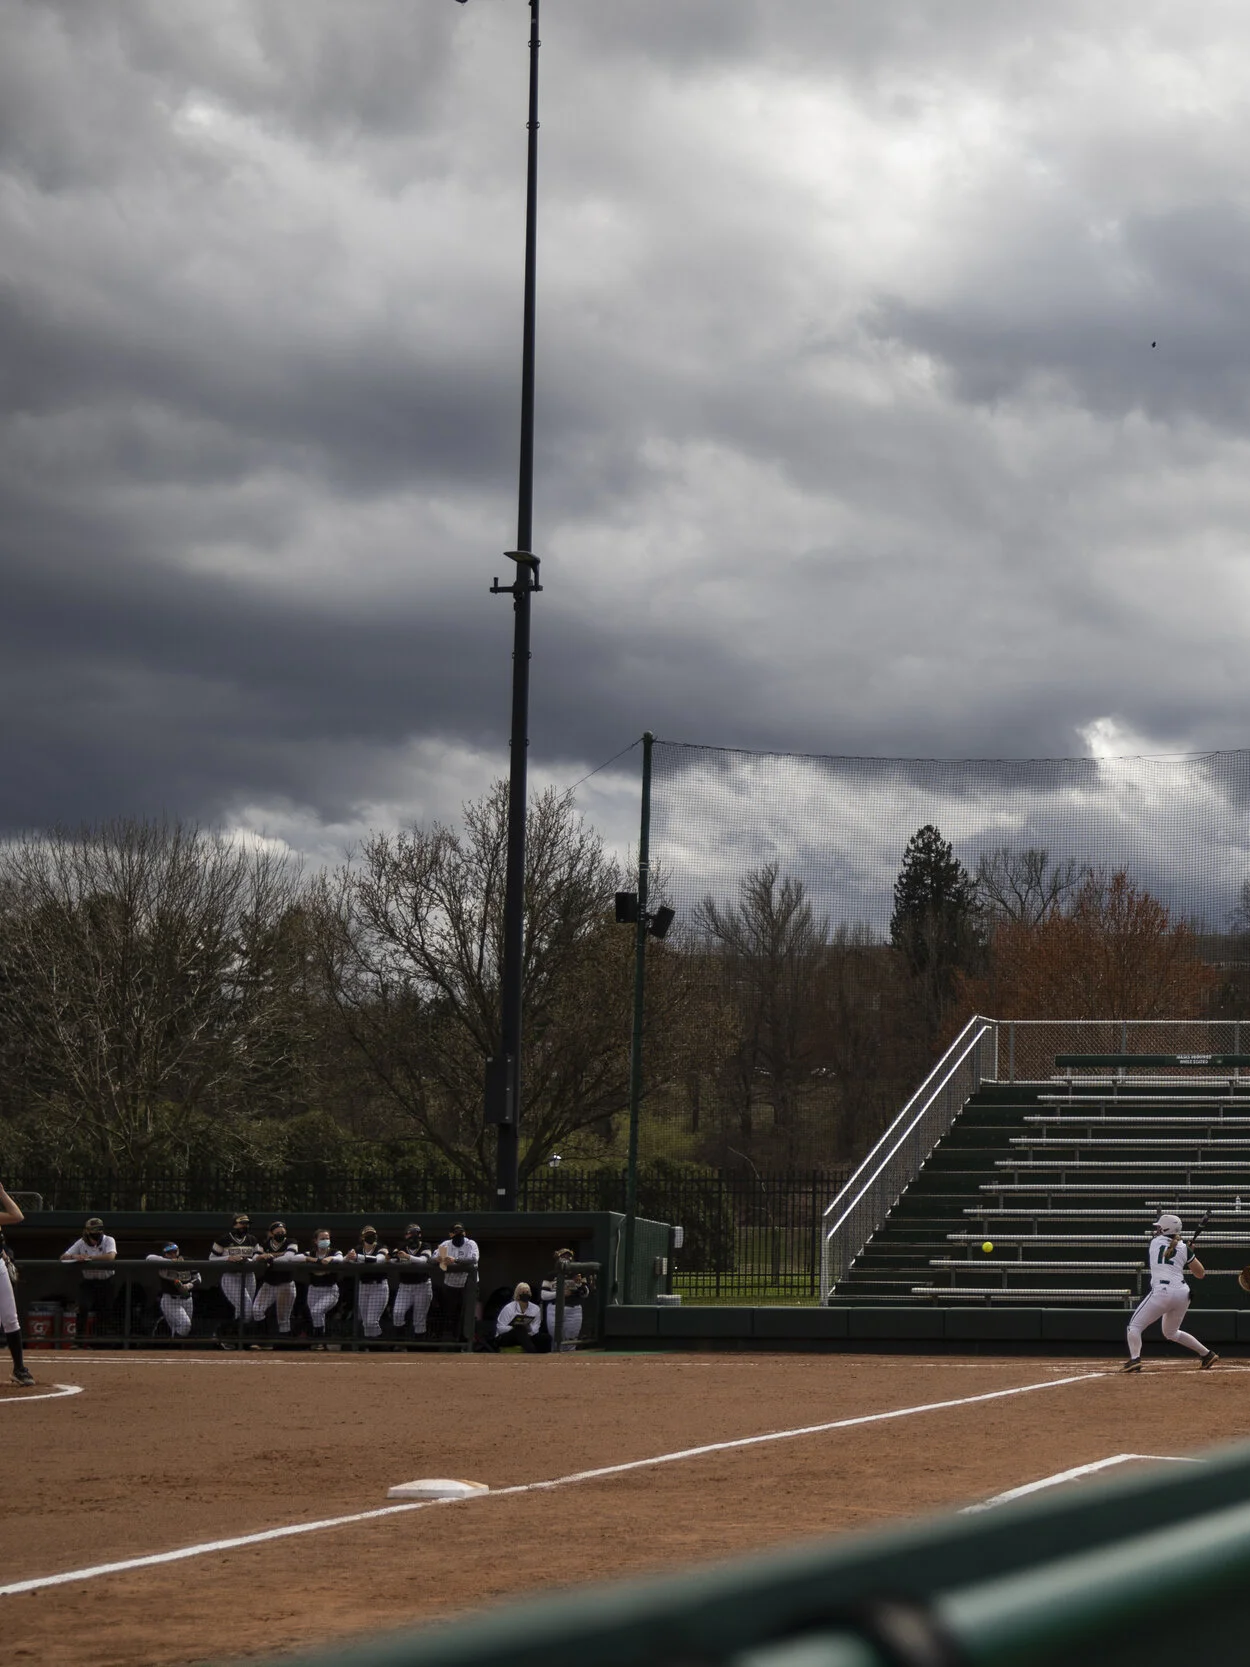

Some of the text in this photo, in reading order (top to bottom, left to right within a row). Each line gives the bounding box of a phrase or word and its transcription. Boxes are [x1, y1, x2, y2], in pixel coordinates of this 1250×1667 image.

[1157, 1245, 1177, 1265] 12
[33, 1322, 44, 1333] G
[66, 1322, 76, 1333] G
